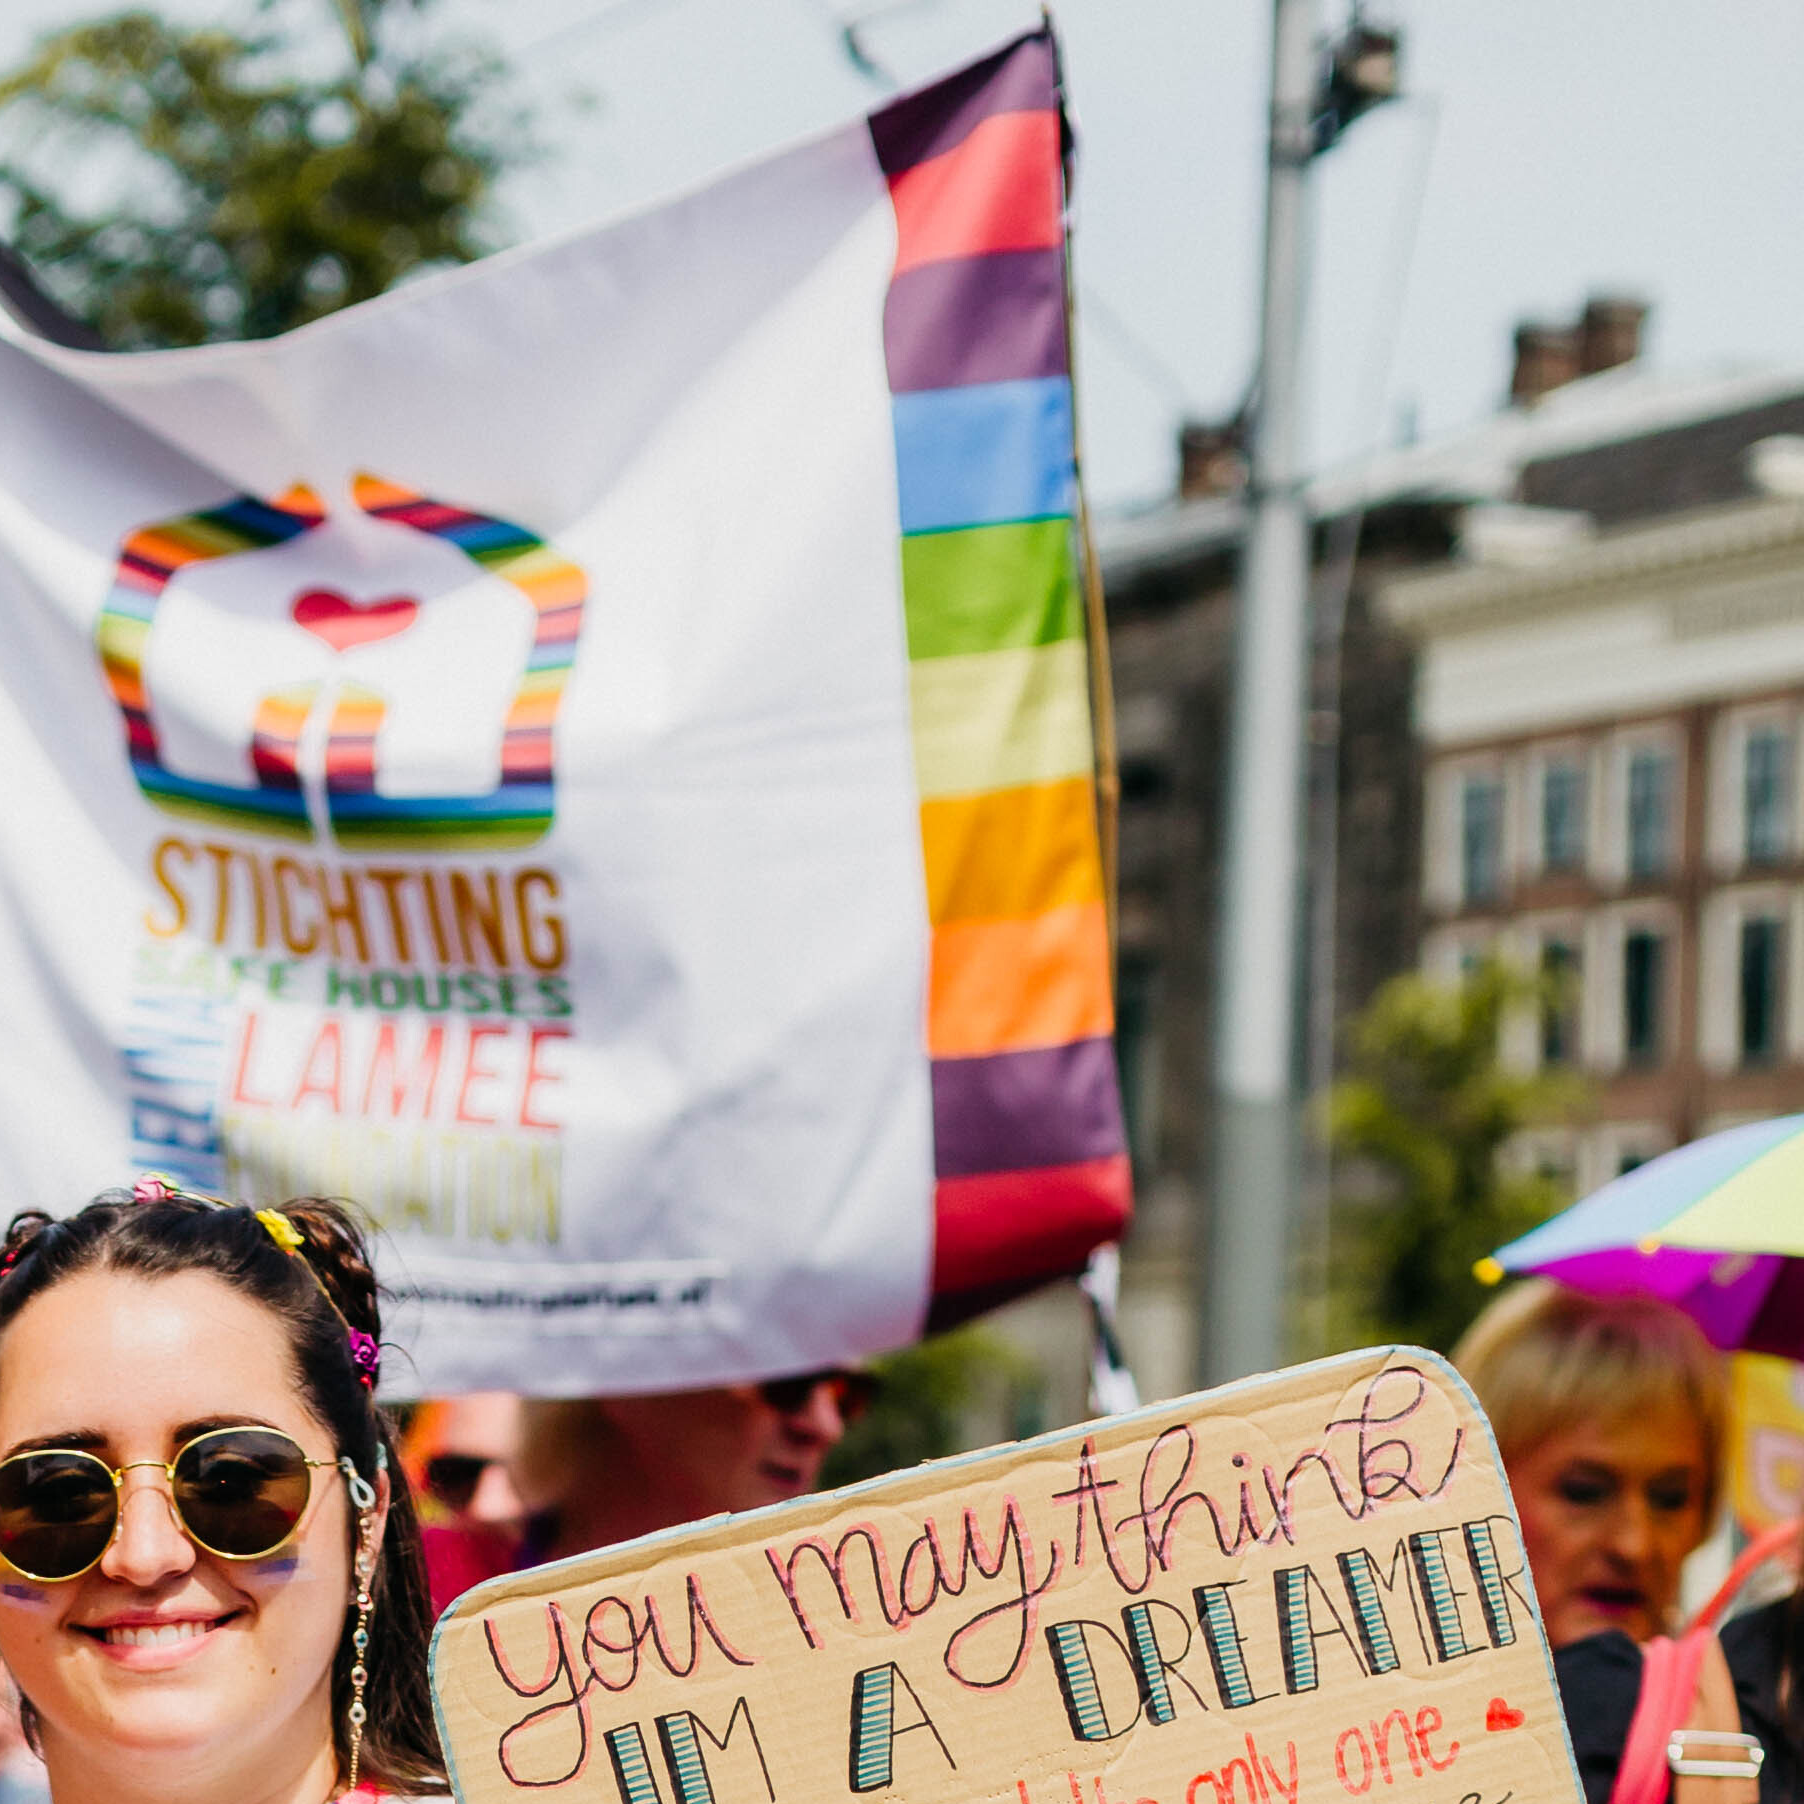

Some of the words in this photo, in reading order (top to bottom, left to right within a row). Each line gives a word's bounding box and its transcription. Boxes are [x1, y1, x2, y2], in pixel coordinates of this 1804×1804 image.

[144, 837, 567, 971] STICHTING
[326, 963, 573, 1018] HOUSES
[231, 1011, 574, 1131] LAMEE
[484, 1570, 756, 1786] you
[767, 1490, 1080, 1690] may
[1053, 1365, 1467, 1595] think
[848, 1659, 958, 1793] A
[1045, 1514, 1532, 1744] DREAMER
[1335, 1704, 1461, 1798] one
